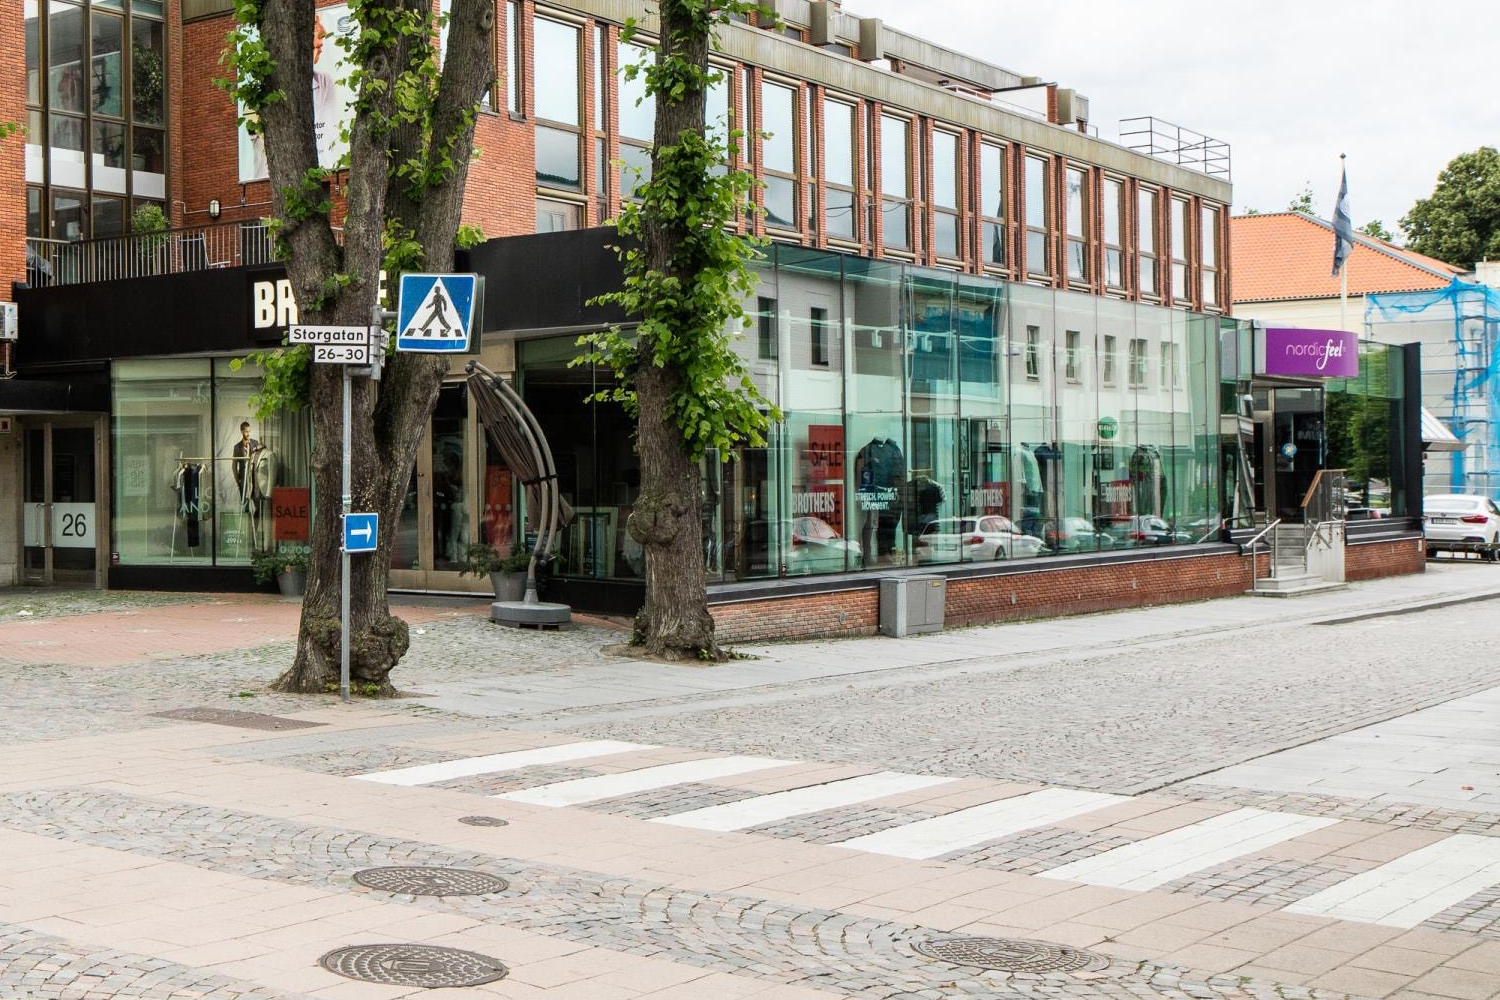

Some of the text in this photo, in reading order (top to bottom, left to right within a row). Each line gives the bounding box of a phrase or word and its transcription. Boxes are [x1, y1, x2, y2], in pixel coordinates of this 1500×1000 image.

[293, 328, 364, 343] Storgatan
[317, 348, 364, 360] 26-30
[1285, 338, 1343, 370] nordicfeel
[811, 441, 842, 468] SALE
[275, 505, 307, 519] SALE
[792, 491, 835, 514] BROTHERS
[61, 512, 87, 538] 26
